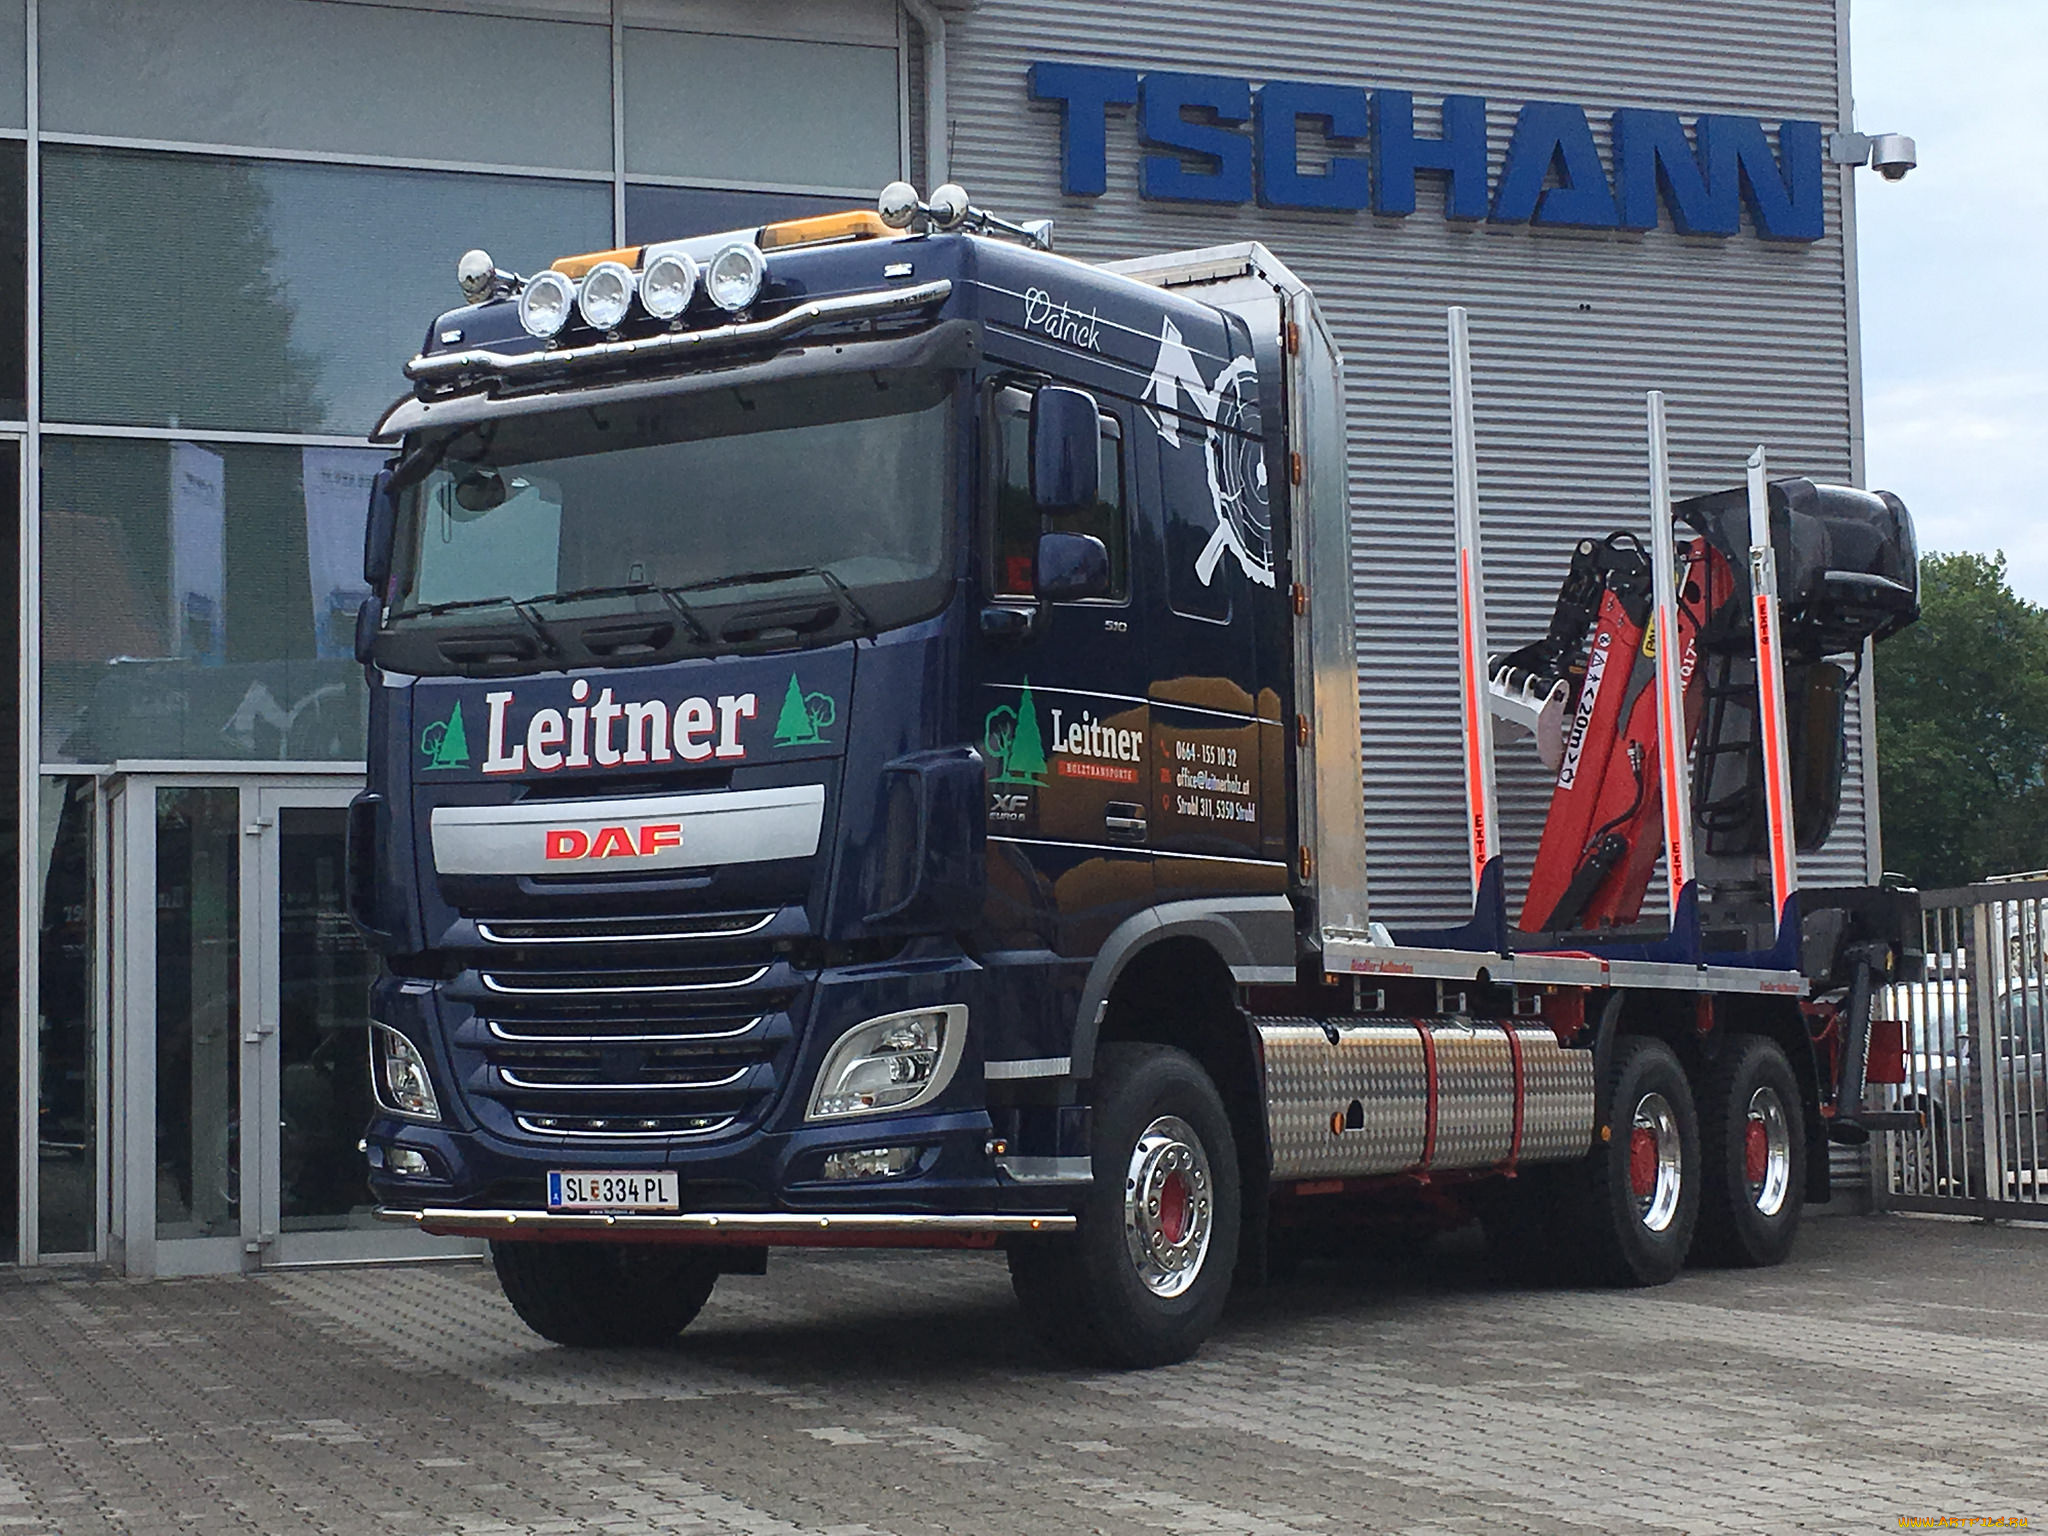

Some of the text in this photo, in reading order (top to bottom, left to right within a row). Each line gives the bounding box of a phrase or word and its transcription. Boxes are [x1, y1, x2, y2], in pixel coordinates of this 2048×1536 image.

[1028, 62, 1825, 242] TSCHANN
[1024, 287, 1100, 352] Patrick
[1104, 620, 1128, 632] 510
[482, 679, 757, 774] Leitner
[1051, 708, 1143, 762] Leitner
[1176, 740, 1196, 761] 0664
[1202, 744, 1215, 764] 155
[1217, 746, 1226, 766] 10
[1227, 748, 1237, 768] 32
[1066, 763, 1132, 780] HOLZTRANSPORTE
[990, 794, 1029, 811] XF
[1177, 795, 1199, 816] Strobl
[1216, 800, 1235, 820] 5350
[545, 823, 684, 861] DAF
[566, 1178, 668, 1203] SL 334 PL
